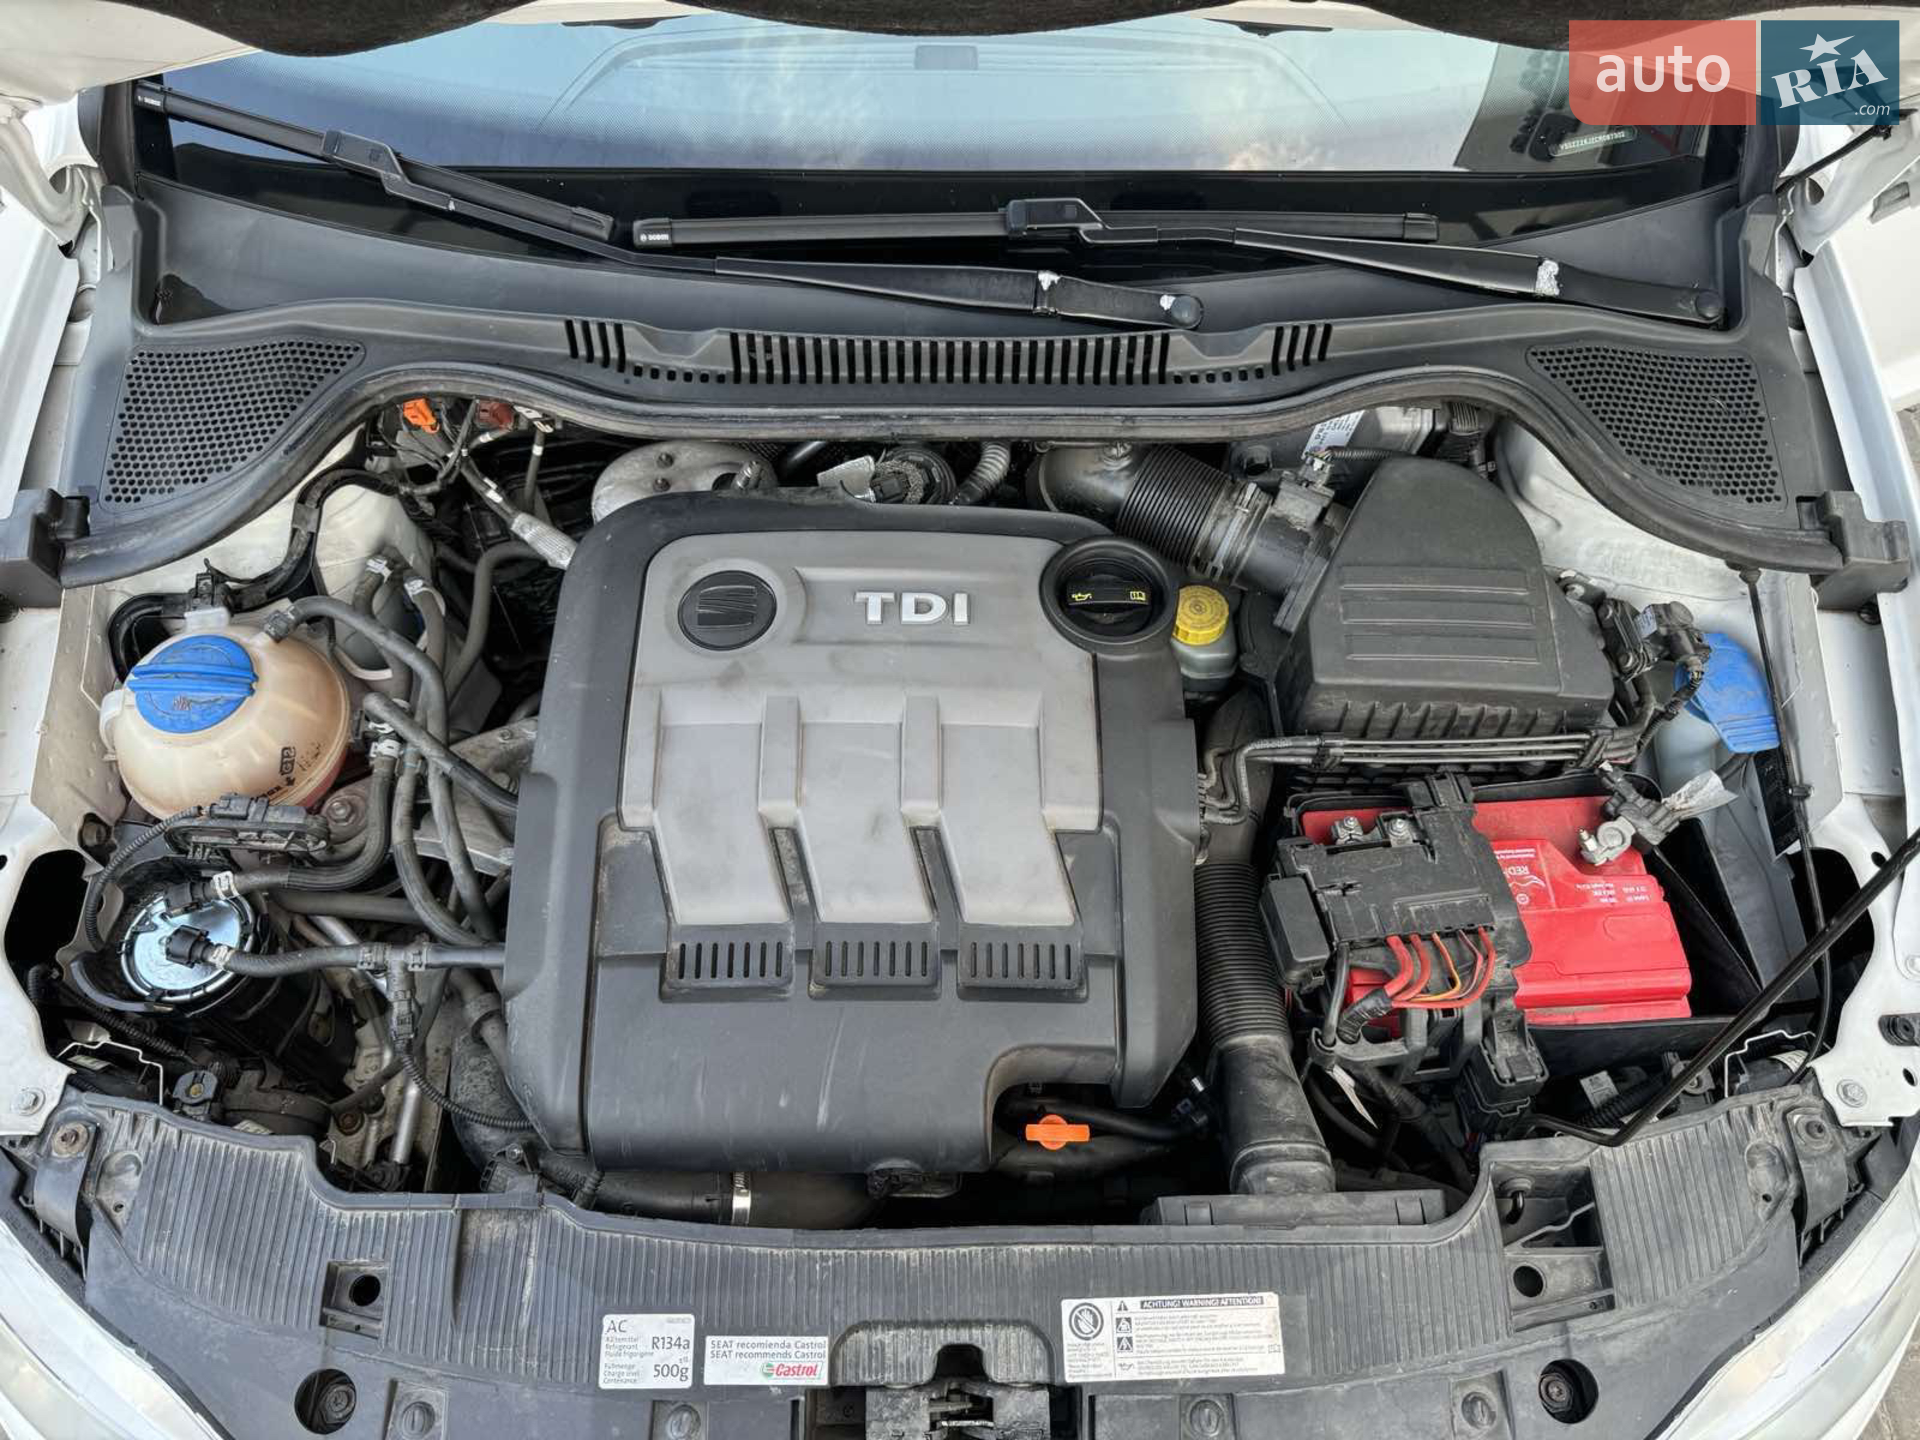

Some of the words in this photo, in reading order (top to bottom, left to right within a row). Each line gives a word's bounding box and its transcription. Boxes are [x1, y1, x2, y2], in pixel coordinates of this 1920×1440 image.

[854, 591, 970, 625] TDI
[1143, 1300, 1180, 1309] ACHTUNG!
[1182, 1299, 1219, 1307] WARNING!
[1220, 1297, 1261, 1306] ATTENTION!
[607, 1320, 627, 1333] AC
[652, 1336, 690, 1350] R134a
[711, 1340, 734, 1349] SEAT
[736, 1340, 791, 1349] recomienda
[794, 1340, 826, 1349] Castrol
[710, 1350, 734, 1359] SEAT
[735, 1350, 792, 1359] recommends
[794, 1350, 826, 1359] Castrol
[654, 1364, 689, 1382] 500g
[775, 1363, 818, 1377] Castrol
